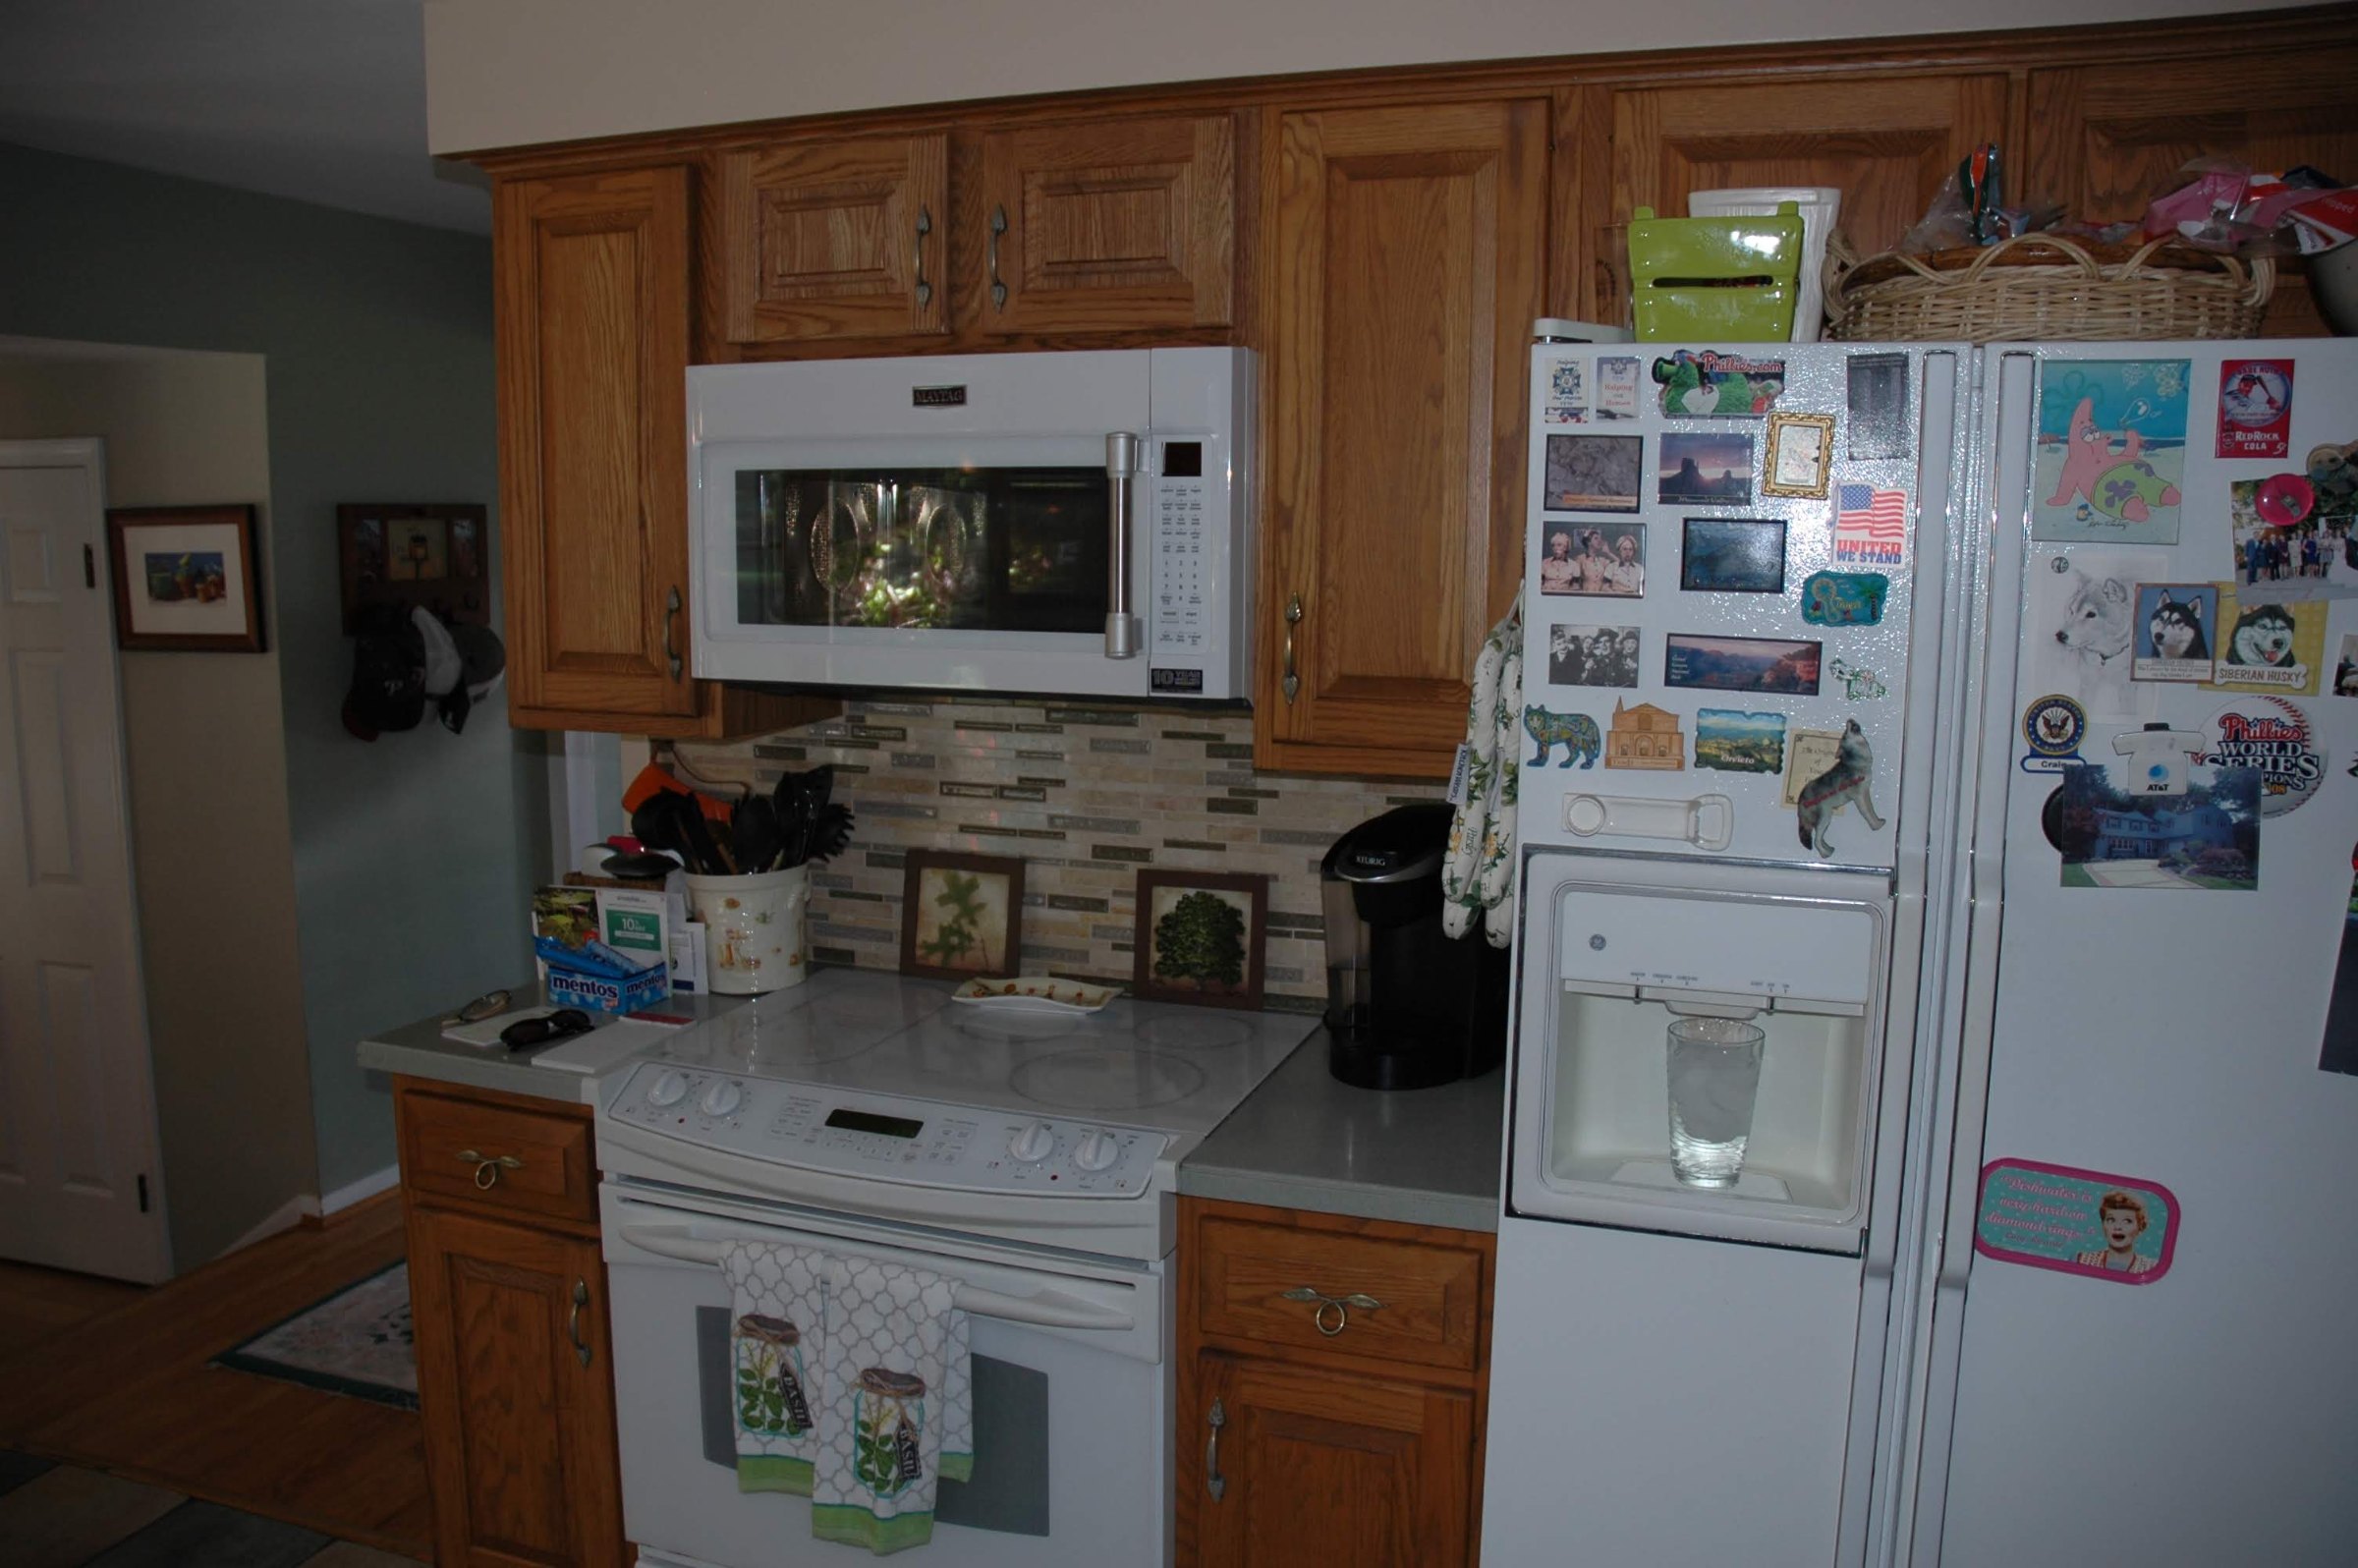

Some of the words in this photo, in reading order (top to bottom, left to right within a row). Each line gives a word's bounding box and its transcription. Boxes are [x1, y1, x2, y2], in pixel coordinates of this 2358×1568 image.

[1701, 352, 1783, 373] Phillies.com
[915, 390, 963, 403] MAYTAG
[2244, 442, 2267, 451] COLA
[1837, 539, 1902, 553] UNITED
[1836, 551, 1857, 563] WE
[1859, 551, 1901, 564] STAND
[1152, 669, 1174, 685] 10
[2218, 667, 2265, 681] SIBERIAN
[2267, 670, 2301, 683] HUSKY
[2218, 712, 2304, 742] Phillies
[2218, 741, 2303, 756] WORLD
[1356, 856, 1386, 867] KEURIG
[621, 918, 635, 931] 10
[553, 976, 619, 998] mentos
[784, 1376, 808, 1427] BASIL
[898, 1429, 916, 1477] BASIL
